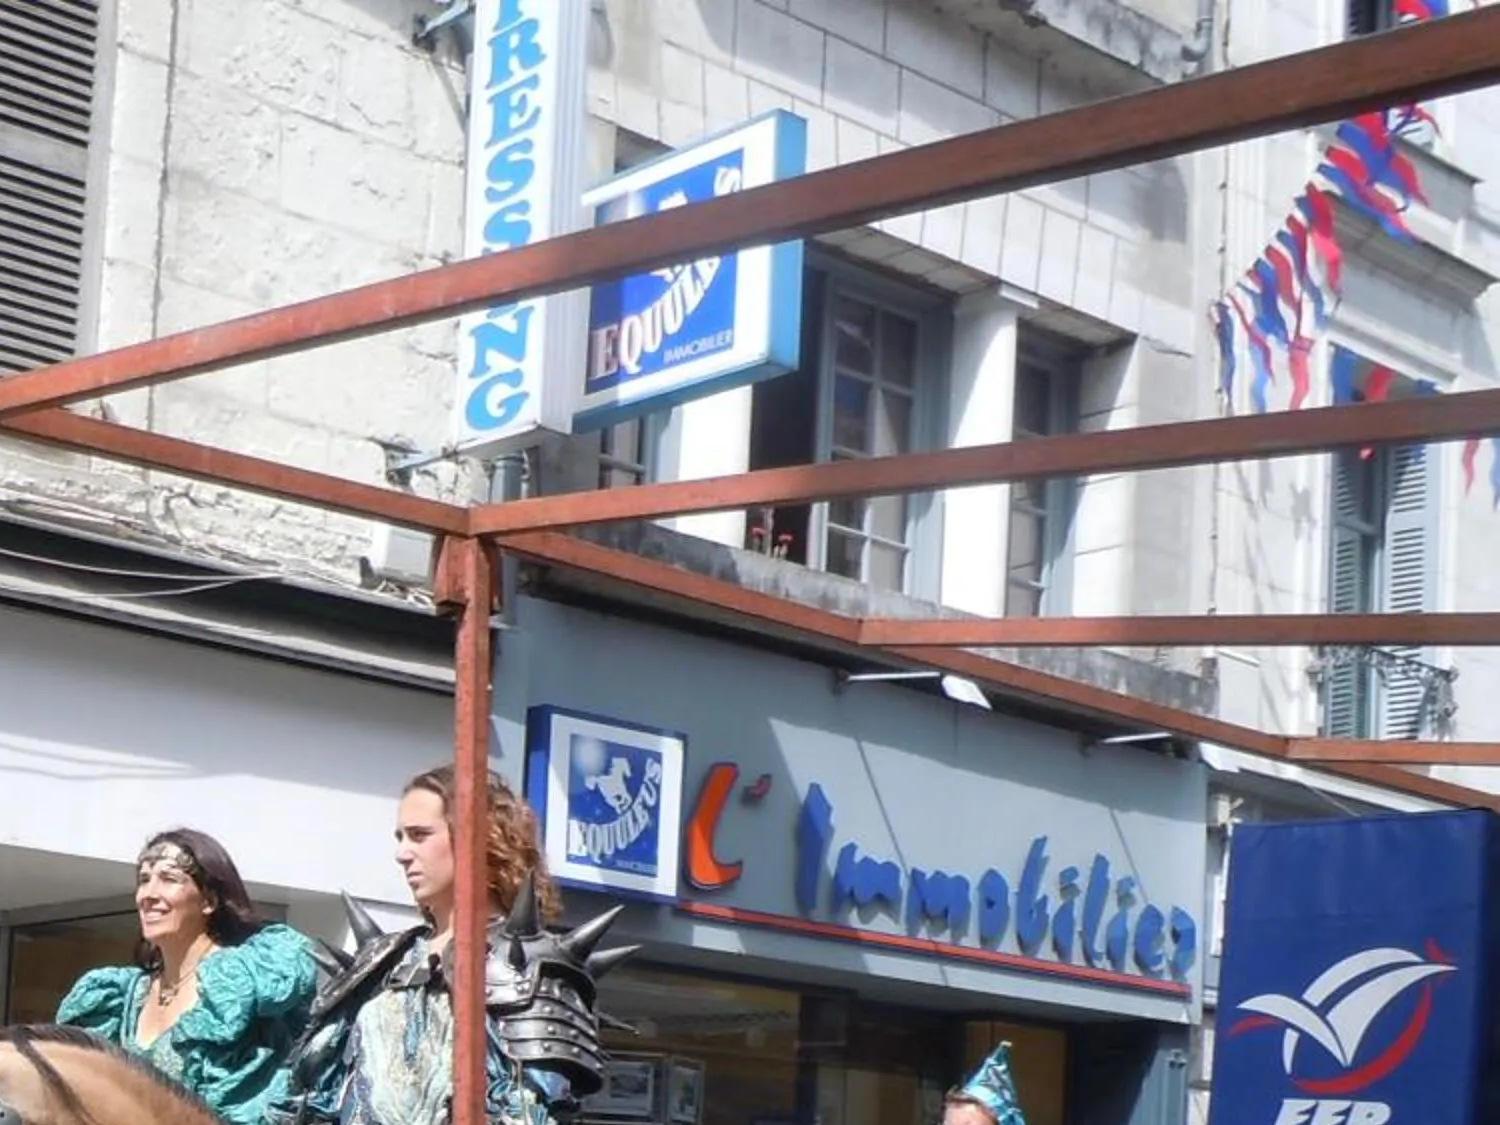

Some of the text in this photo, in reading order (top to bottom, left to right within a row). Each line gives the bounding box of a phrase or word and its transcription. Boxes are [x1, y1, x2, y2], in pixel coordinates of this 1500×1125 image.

[464, 0, 547, 431] RESSNG
[589, 166, 742, 376] EQUULES
[567, 757, 663, 863] EQUULEUS
